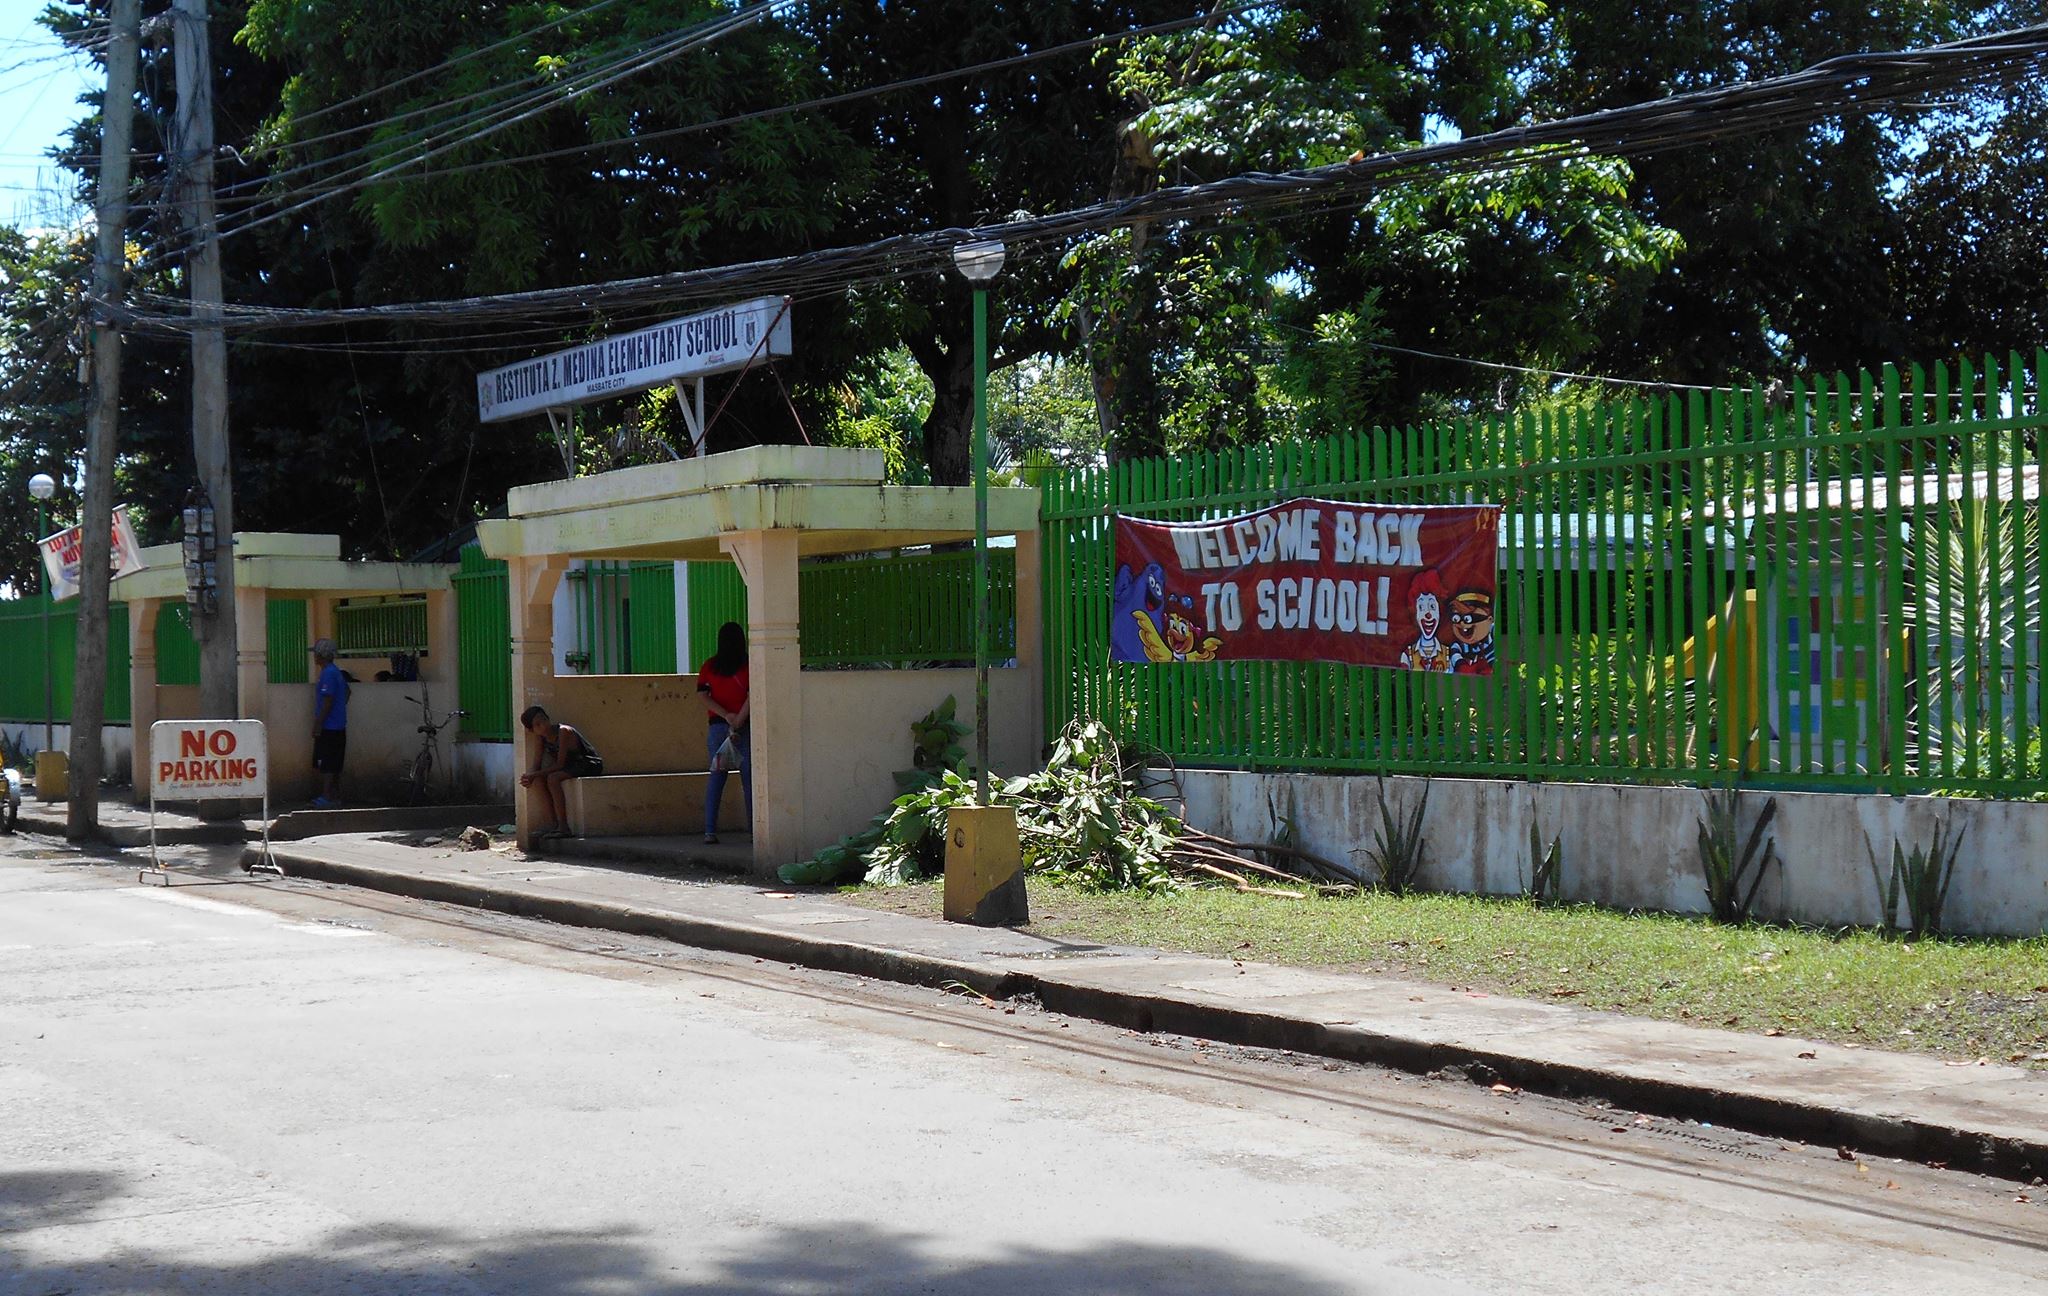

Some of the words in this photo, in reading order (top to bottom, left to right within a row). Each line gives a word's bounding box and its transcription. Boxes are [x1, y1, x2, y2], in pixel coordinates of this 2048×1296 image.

[496, 360, 549, 404] RESTITUTA
[552, 358, 561, 389] Z.
[563, 345, 605, 387] MEDINA
[608, 323, 682, 375] ELEMENTARY
[687, 310, 738, 358] SCHOOL
[587, 379, 612, 393] MASBATE
[612, 376, 626, 389] CITY
[1170, 508, 1321, 569] WELCOME
[1335, 511, 1425, 567] BACK
[1201, 582, 1243, 632] TO
[180, 729, 238, 758] NO
[159, 758, 258, 782] PARKING
